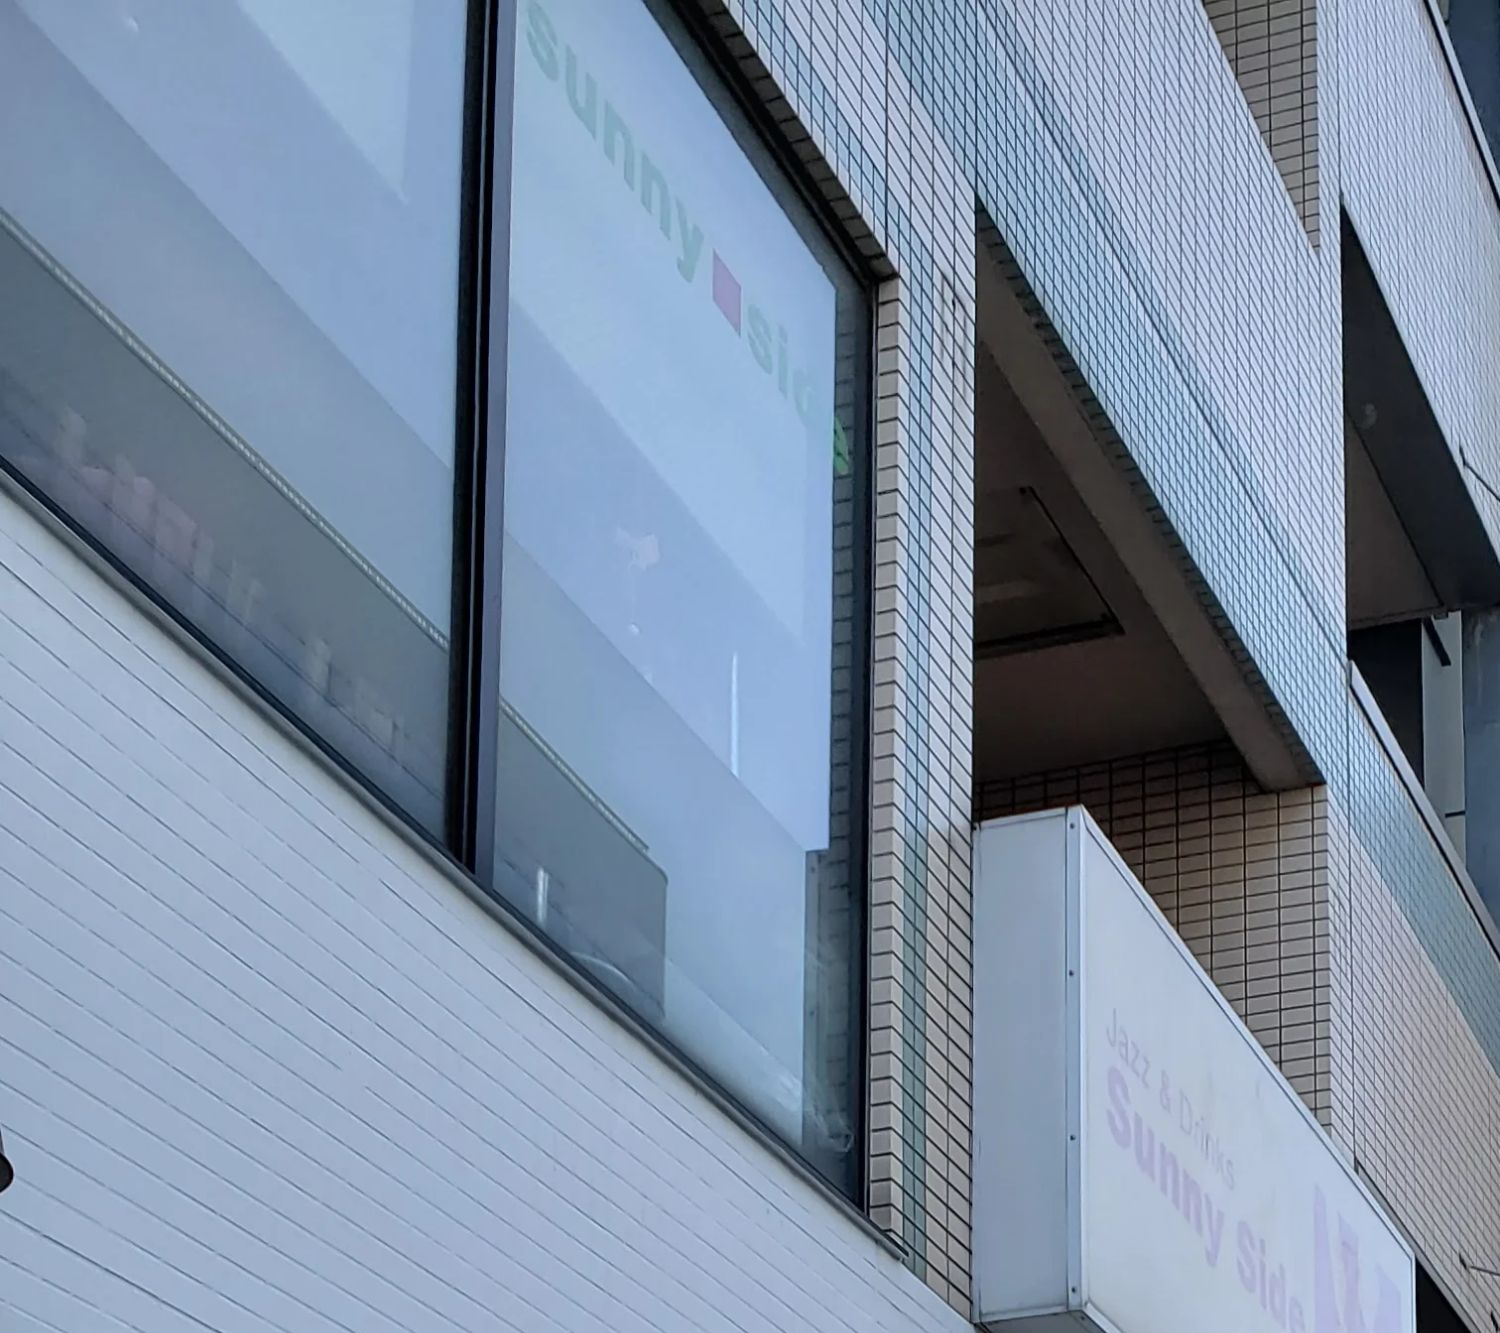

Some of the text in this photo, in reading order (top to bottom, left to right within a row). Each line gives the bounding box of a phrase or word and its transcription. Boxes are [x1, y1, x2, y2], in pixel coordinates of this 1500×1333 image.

[526, 3, 704, 283] sunny
[1105, 1008, 1236, 1192] Jazz & Drinks
[1106, 1064, 1226, 1268] Sunny
